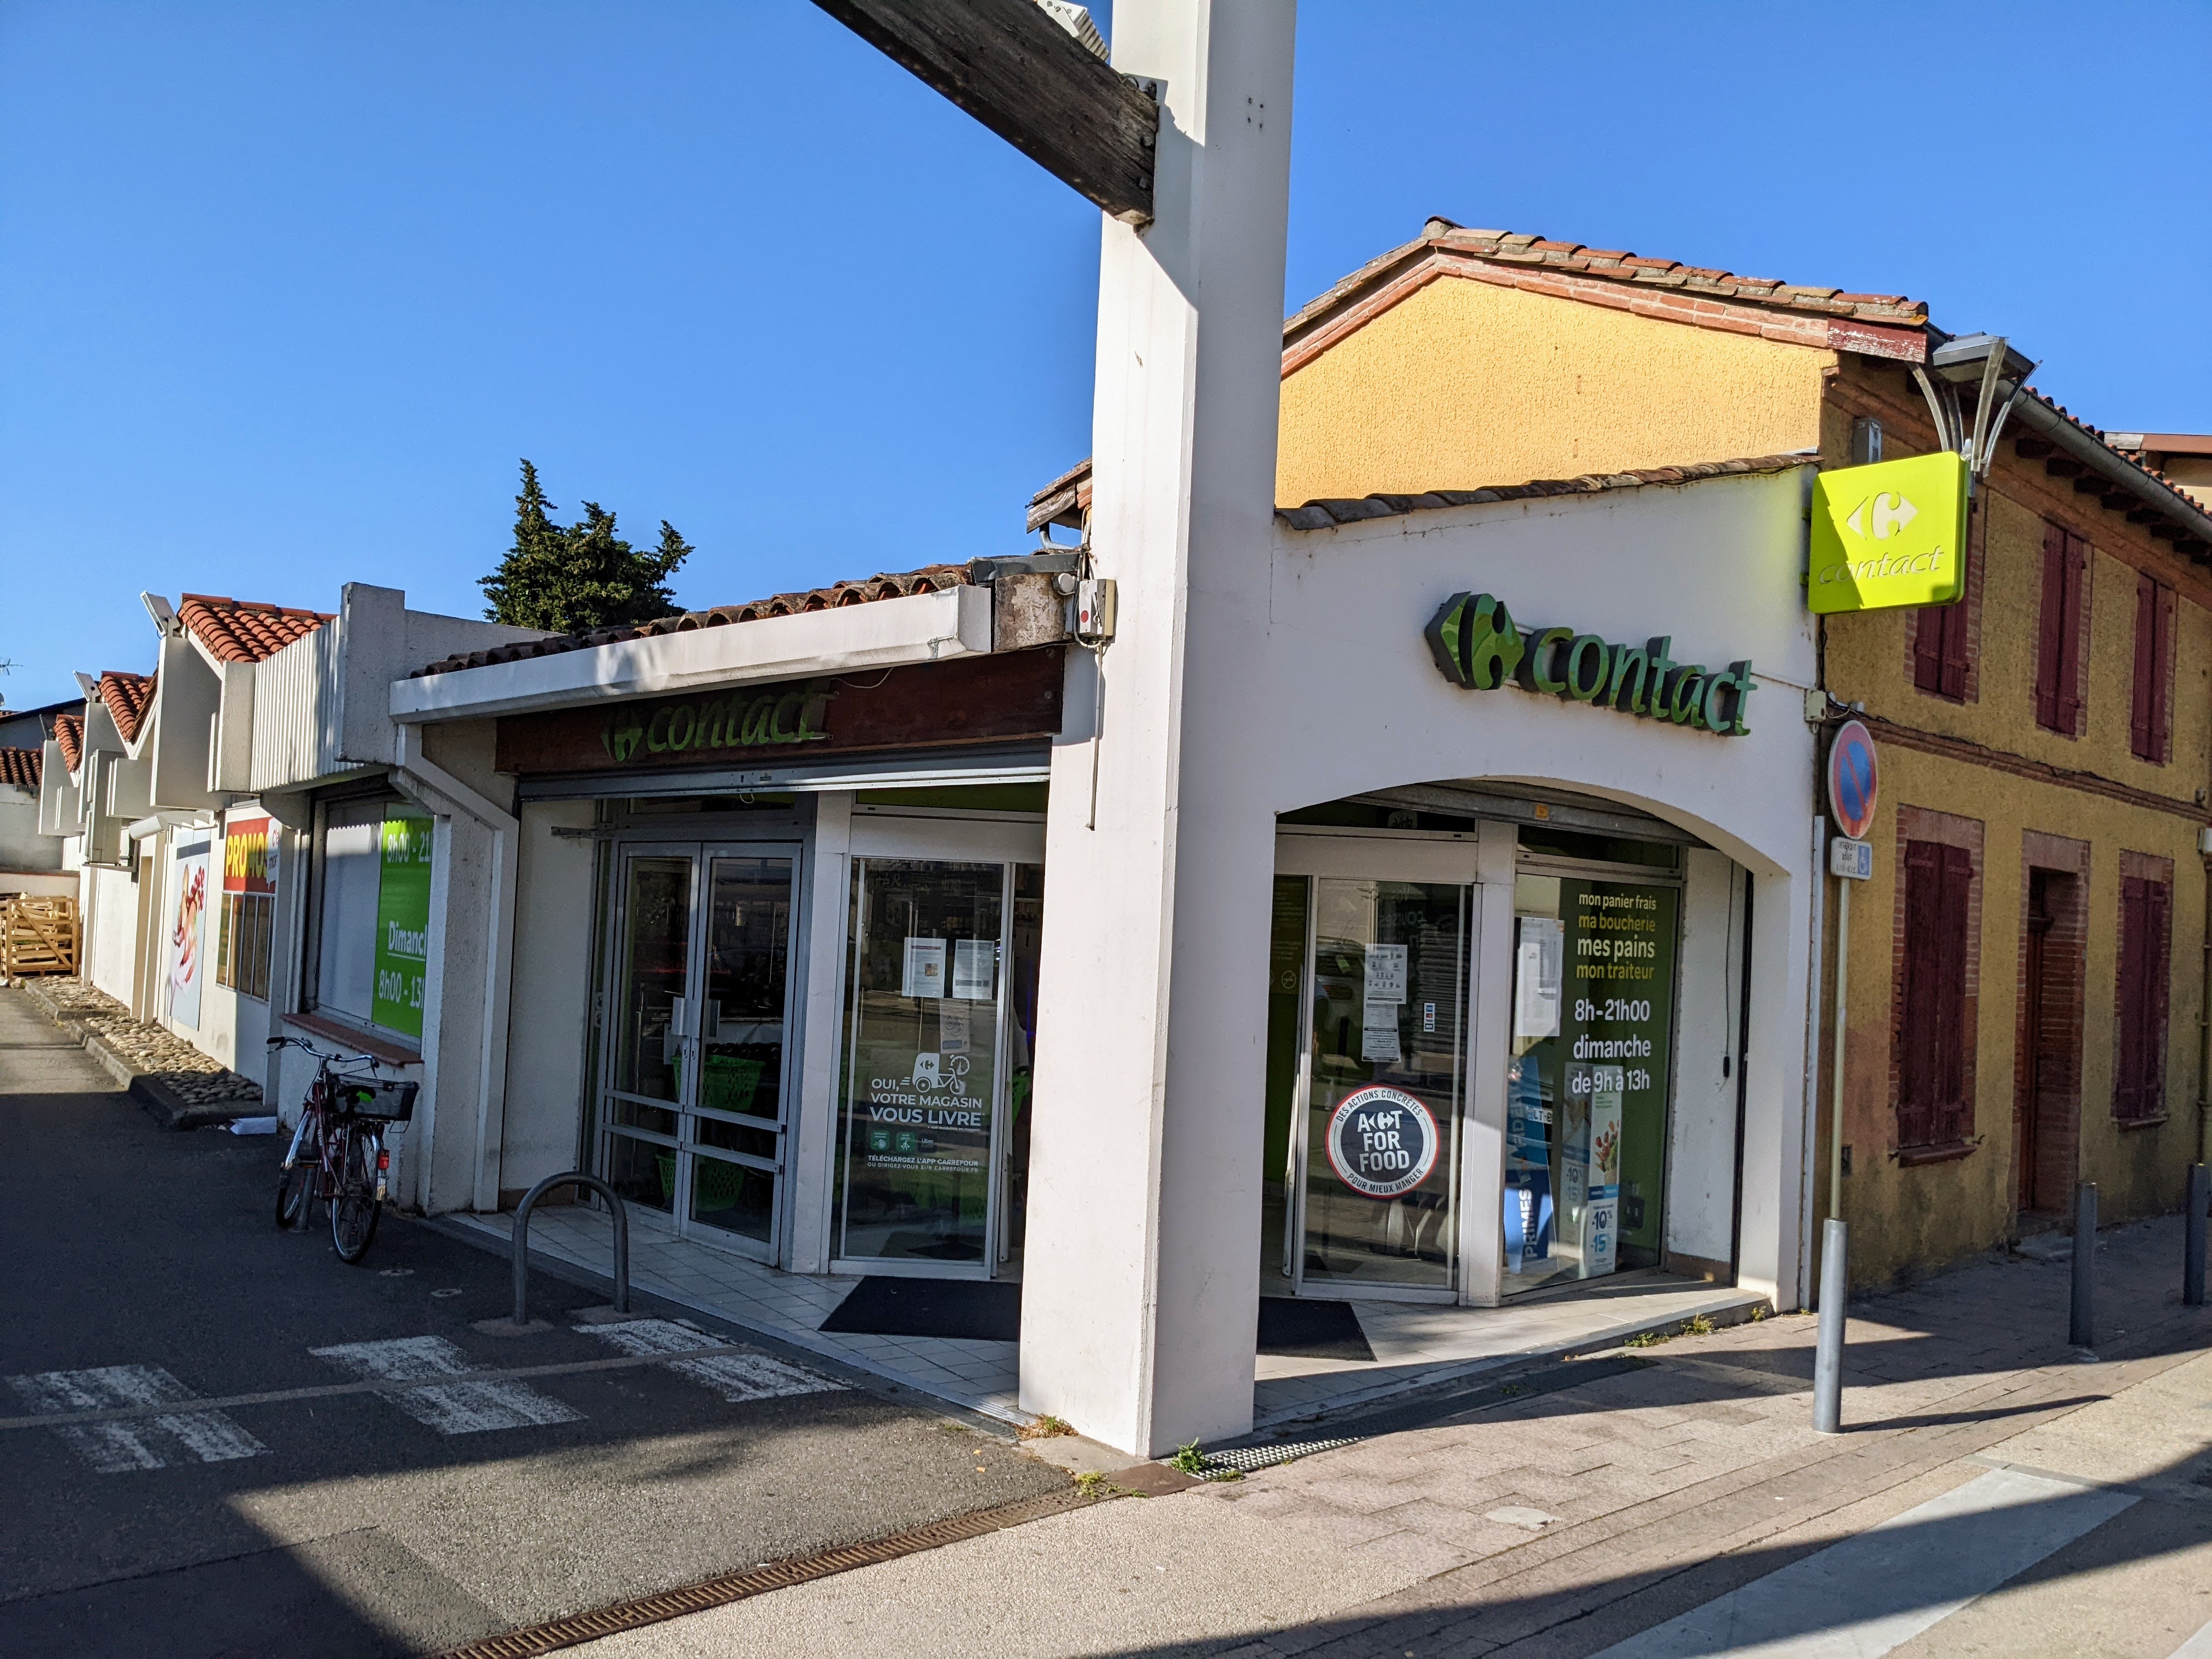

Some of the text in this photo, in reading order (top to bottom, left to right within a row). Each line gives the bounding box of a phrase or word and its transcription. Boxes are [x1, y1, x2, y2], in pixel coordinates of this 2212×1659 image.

[1819, 545, 1944, 585] contact
[1528, 627, 1758, 736] contact
[646, 680, 837, 752] contact
[387, 832, 410, 863] 8h00
[1578, 893, 1656, 910] mon panier frais
[1578, 912, 1656, 932] ma boucherie
[1577, 934, 1655, 963] mes pains
[1576, 961, 1655, 979] mon traiteur
[379, 968, 402, 1003] 8h00
[1573, 1034, 1651, 1059] dimanche
[871, 1078, 900, 1092] OUI,
[1572, 1071, 1591, 1094] de
[1594, 1070, 1612, 1093] 9h
[1615, 1068, 1623, 1091] à
[1627, 1068, 1650, 1091] 13h
[871, 1092, 982, 1109] VOTRE MAGASIN
[1335, 1090, 1423, 1122] DES ACTIONS CONCRÈTES
[870, 1107, 923, 1123] VOUS
[1363, 1131, 1401, 1152] FOR
[868, 1154, 978, 1167] TÉLÉCHARGEZ L'APP CARREFOUR
[1359, 1150, 1410, 1172] FOOD
[1347, 1168, 1424, 1193] POUR MIEUX MANGER
[1519, 1188, 1538, 1258] PRIMES
